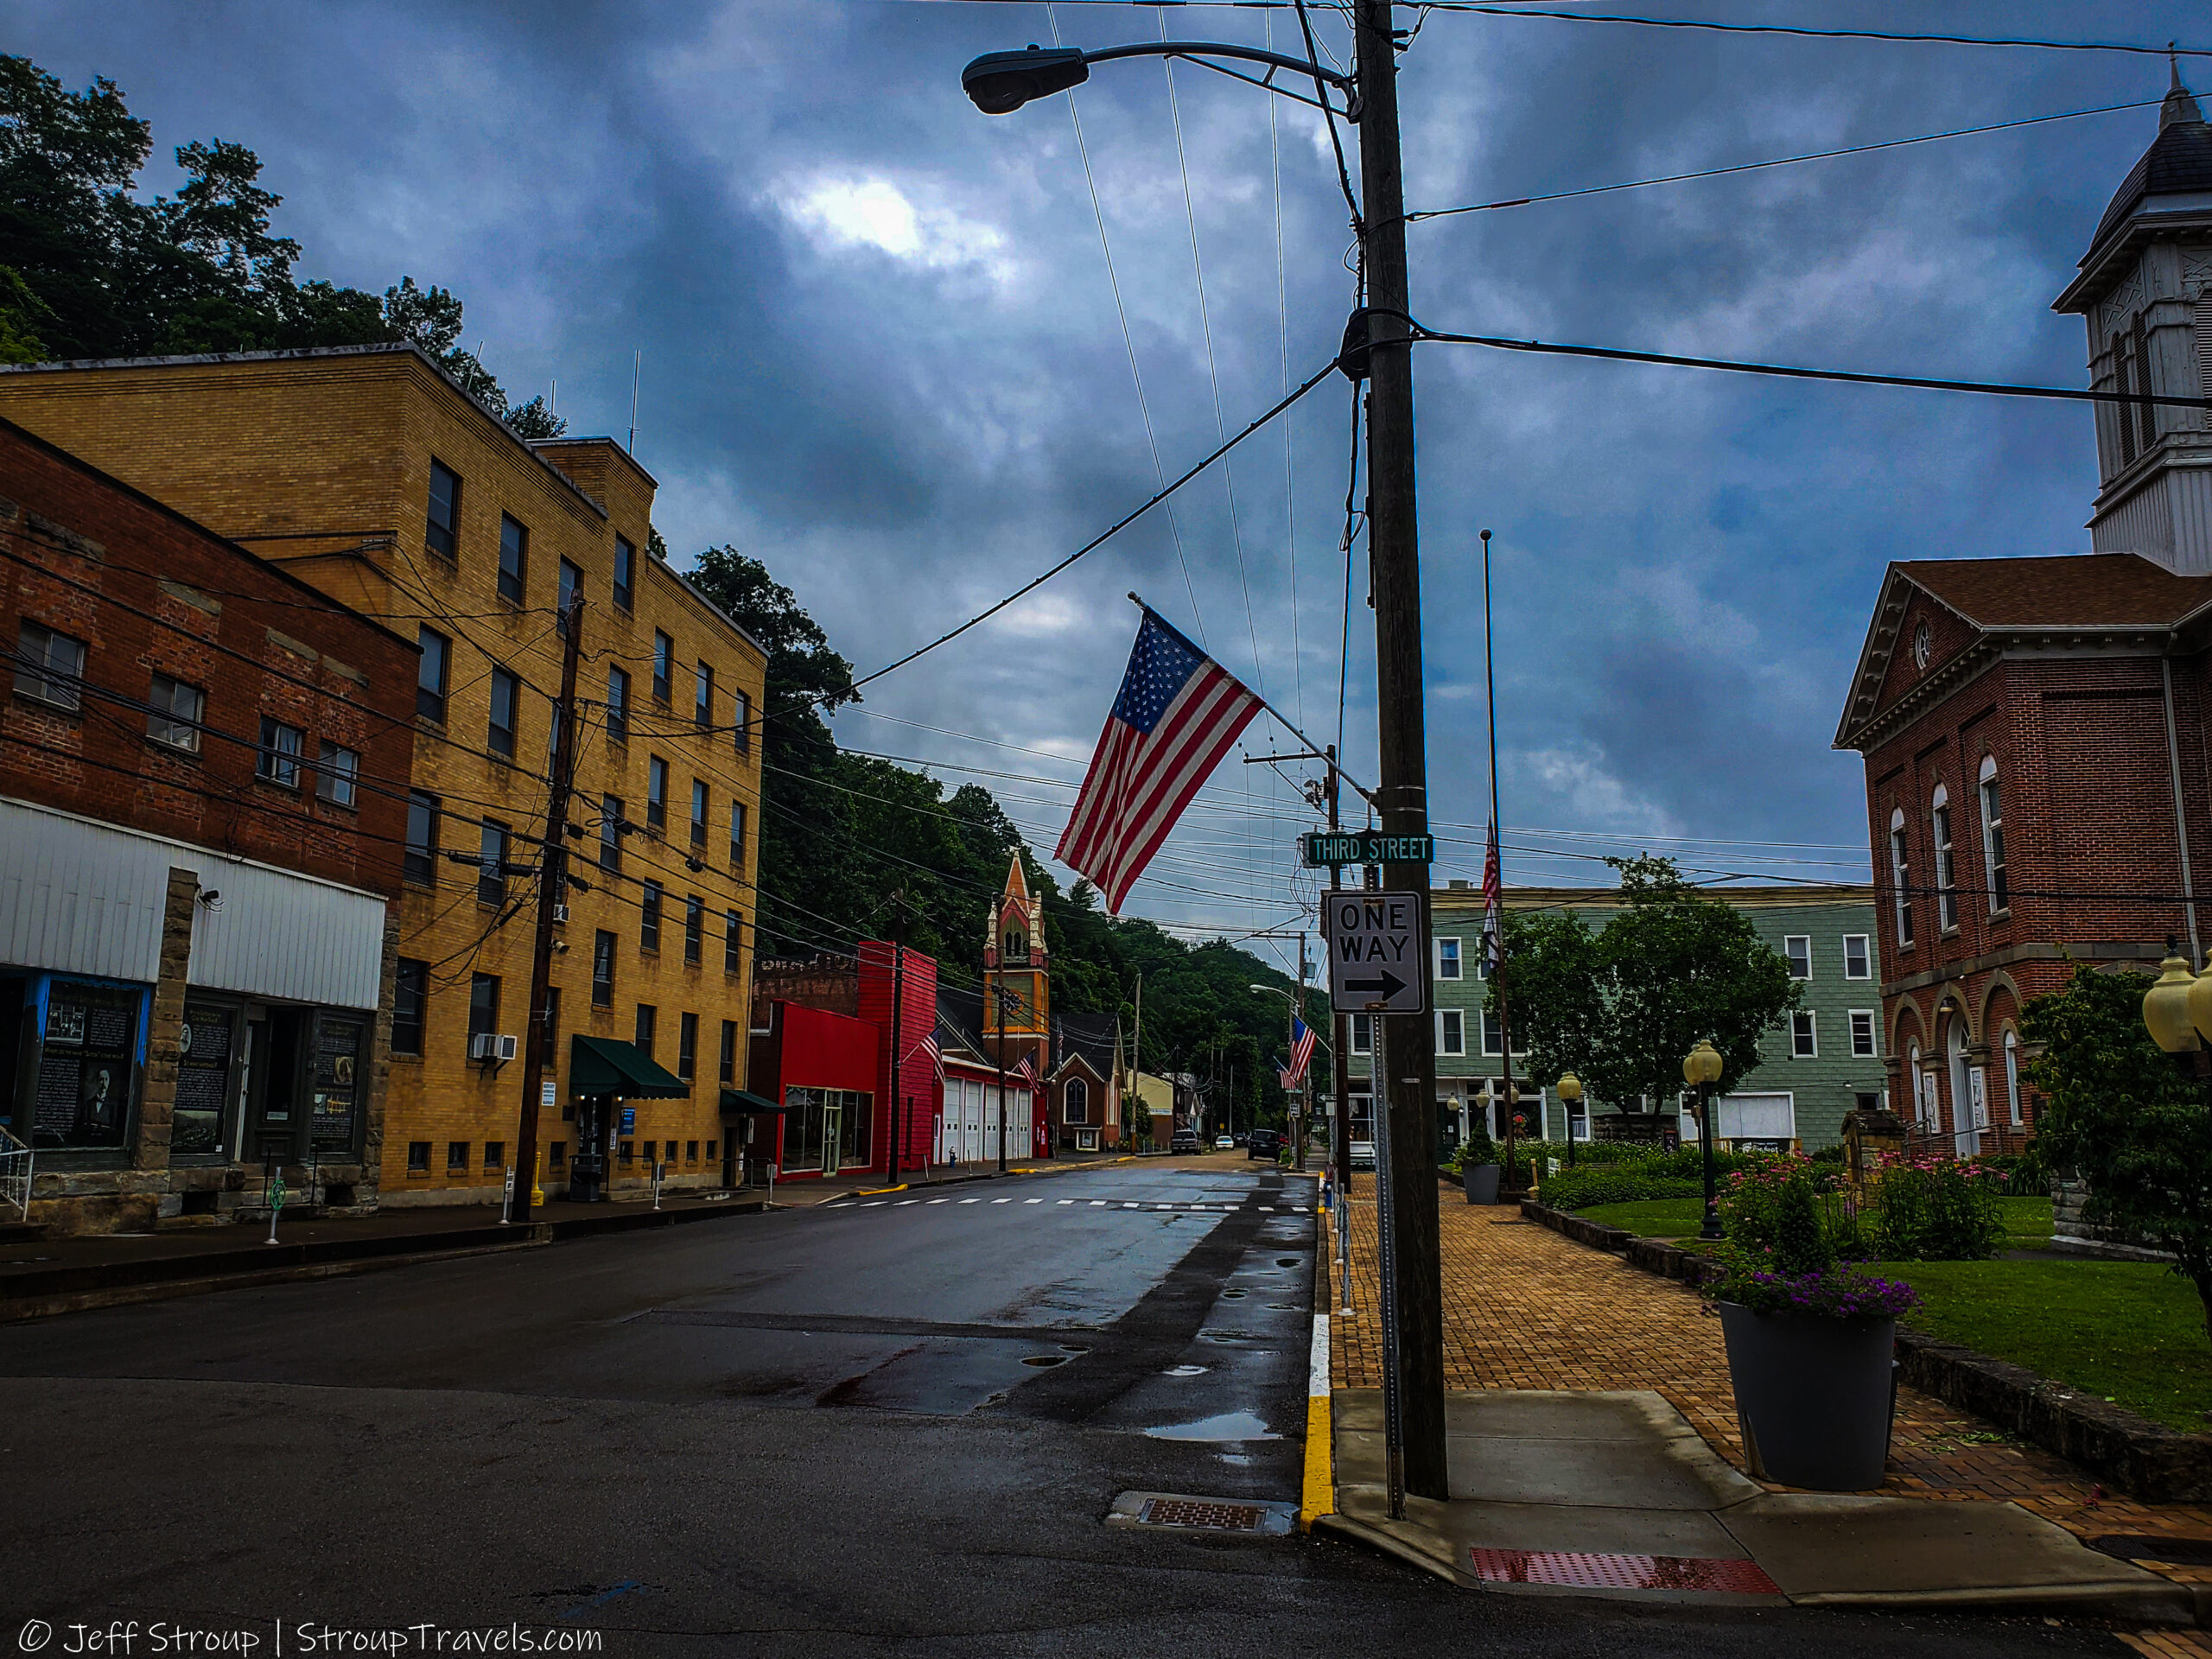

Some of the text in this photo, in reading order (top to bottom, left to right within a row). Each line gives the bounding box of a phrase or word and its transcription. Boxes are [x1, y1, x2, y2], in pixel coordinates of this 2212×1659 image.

[1313, 837, 1428, 861] THIRD STREET
[1340, 903, 1408, 931] ONE
[1338, 935, 1410, 963] WAY
